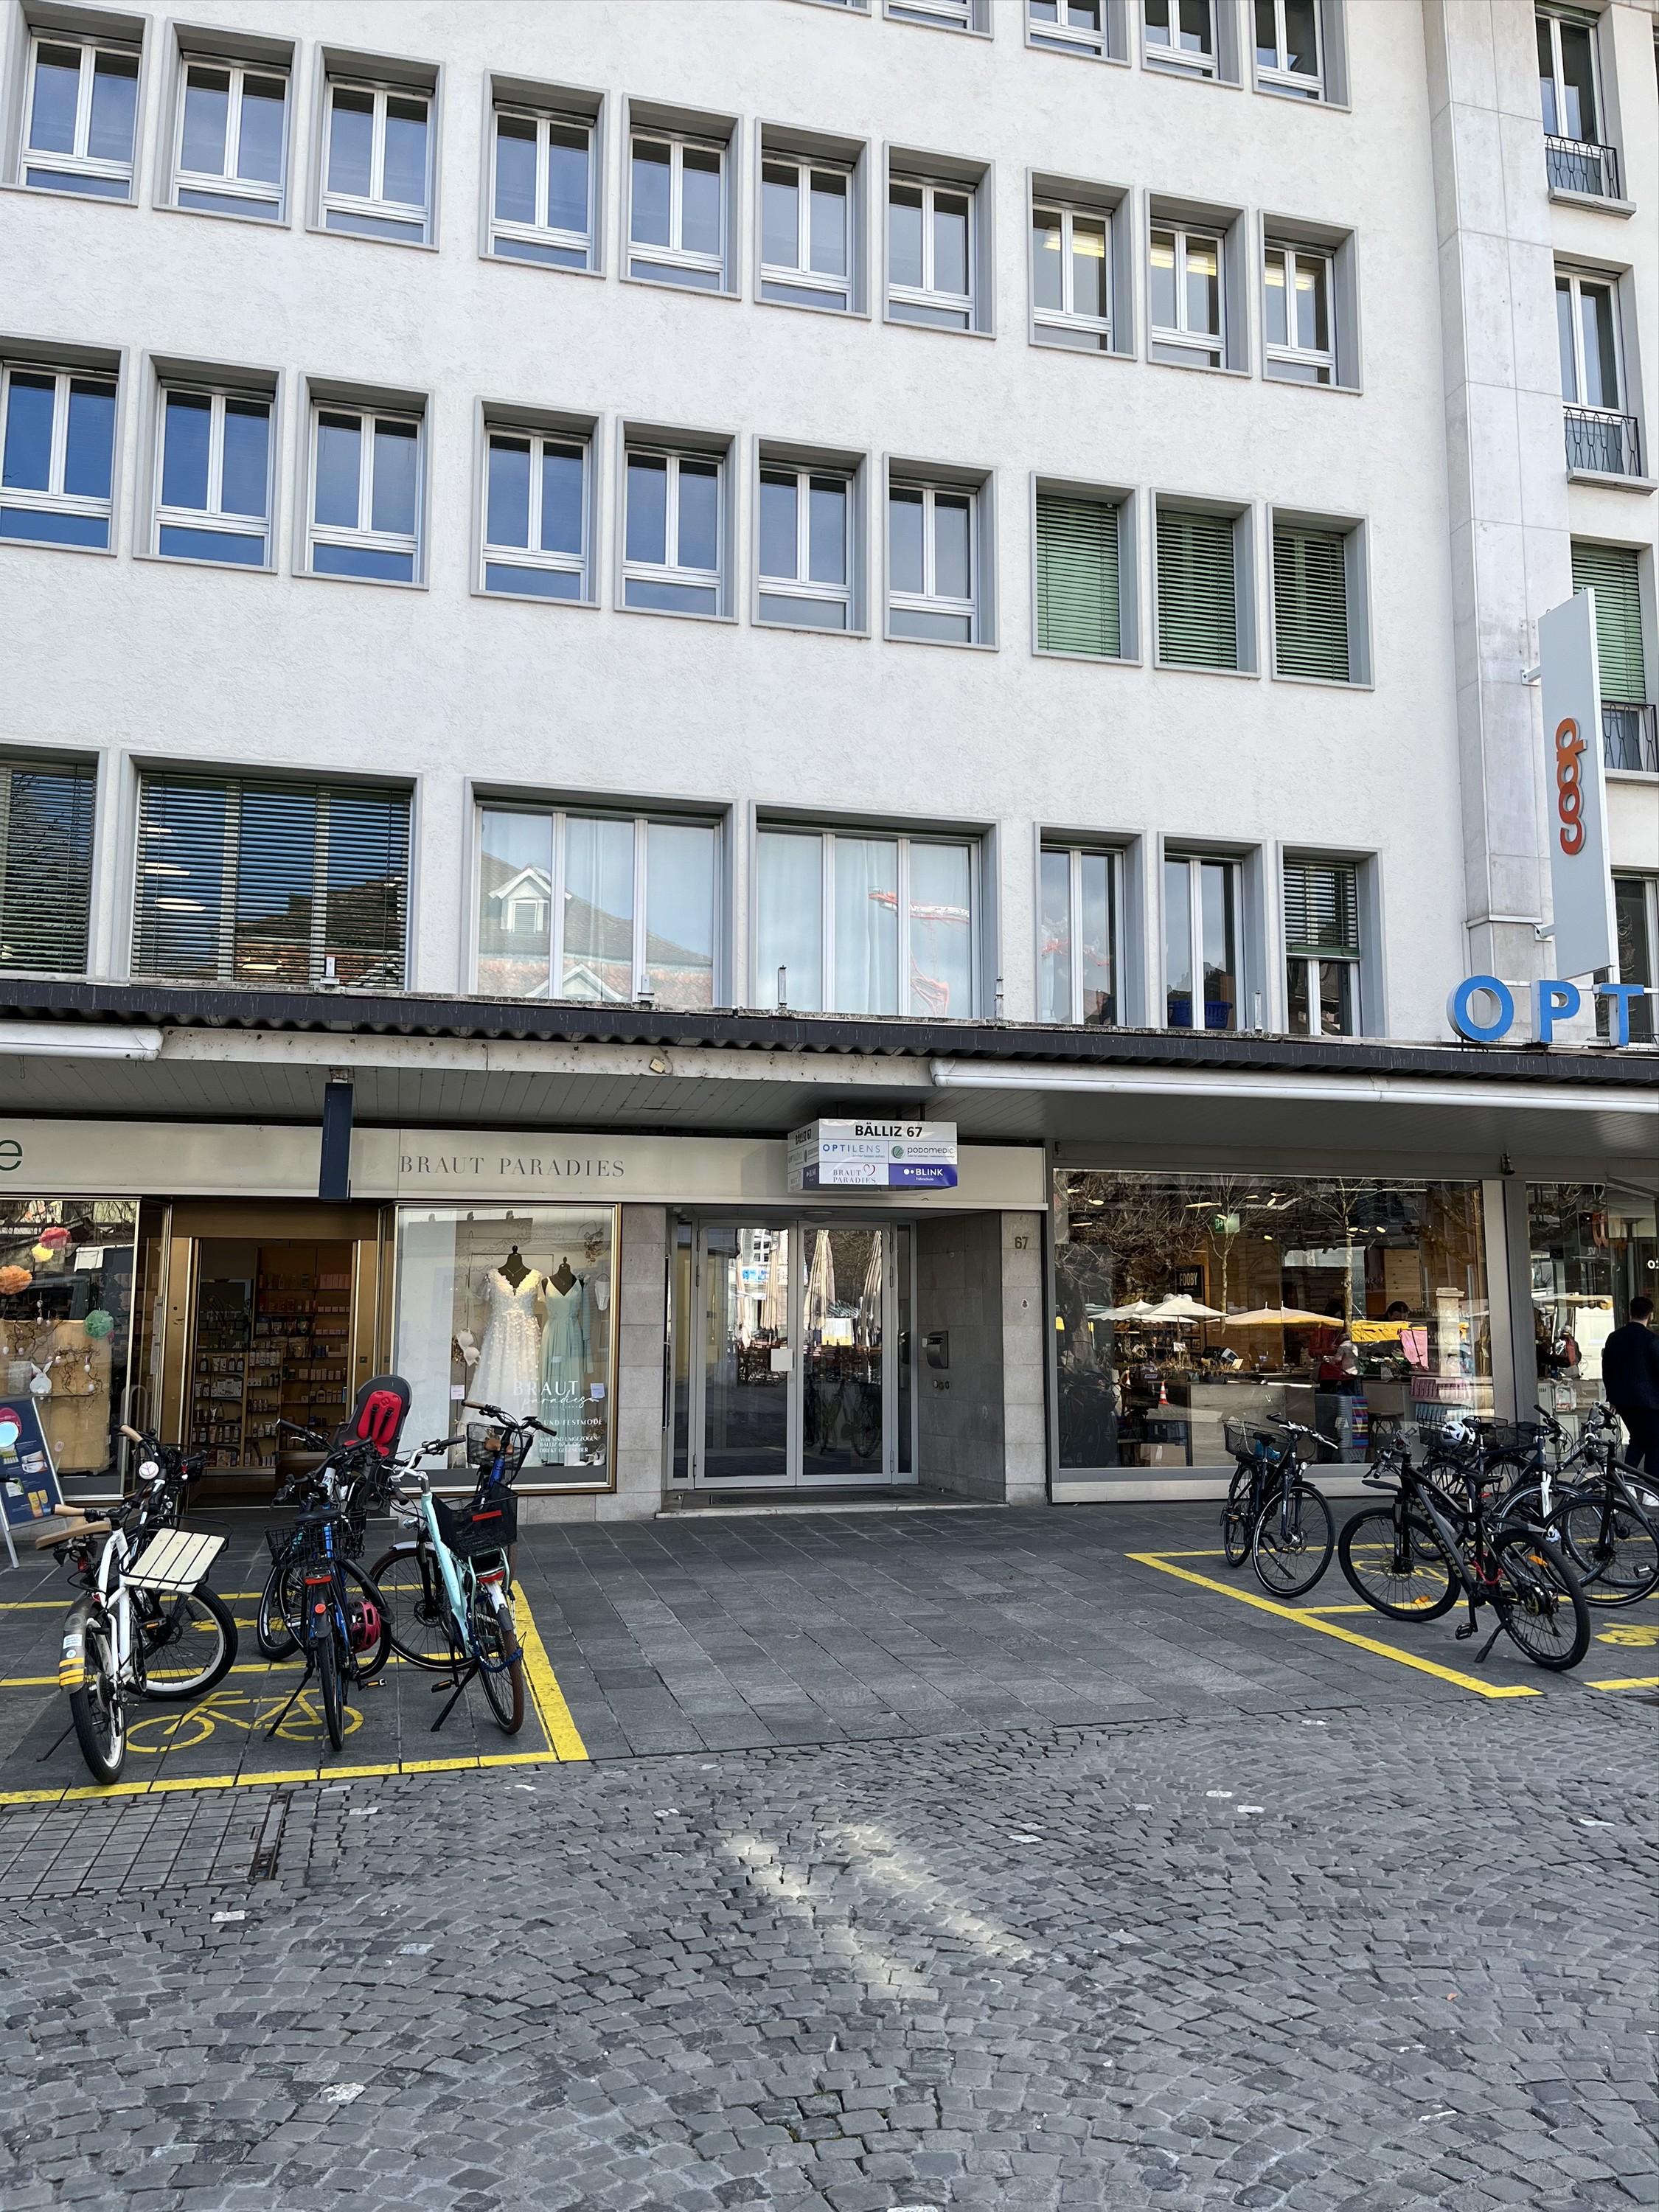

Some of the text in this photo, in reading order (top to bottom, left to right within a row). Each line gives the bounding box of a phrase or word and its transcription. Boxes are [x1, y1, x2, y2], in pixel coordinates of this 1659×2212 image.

[1556, 717, 1587, 855] coop
[1447, 975, 1644, 1047] OPT
[855, 1122, 923, 1138] BÄLLIZ 67
[822, 1144, 881, 1153] OPTILENS
[399, 1155, 625, 1178] BRAUT PARADIES
[915, 1168, 943, 1176] BLINK
[1015, 1236, 1029, 1250] 67
[1180, 1272, 1198, 1287] FOOBY
[513, 1380, 579, 1396] BRAUT
[1415, 1497, 1463, 1578] ALLEGRO
